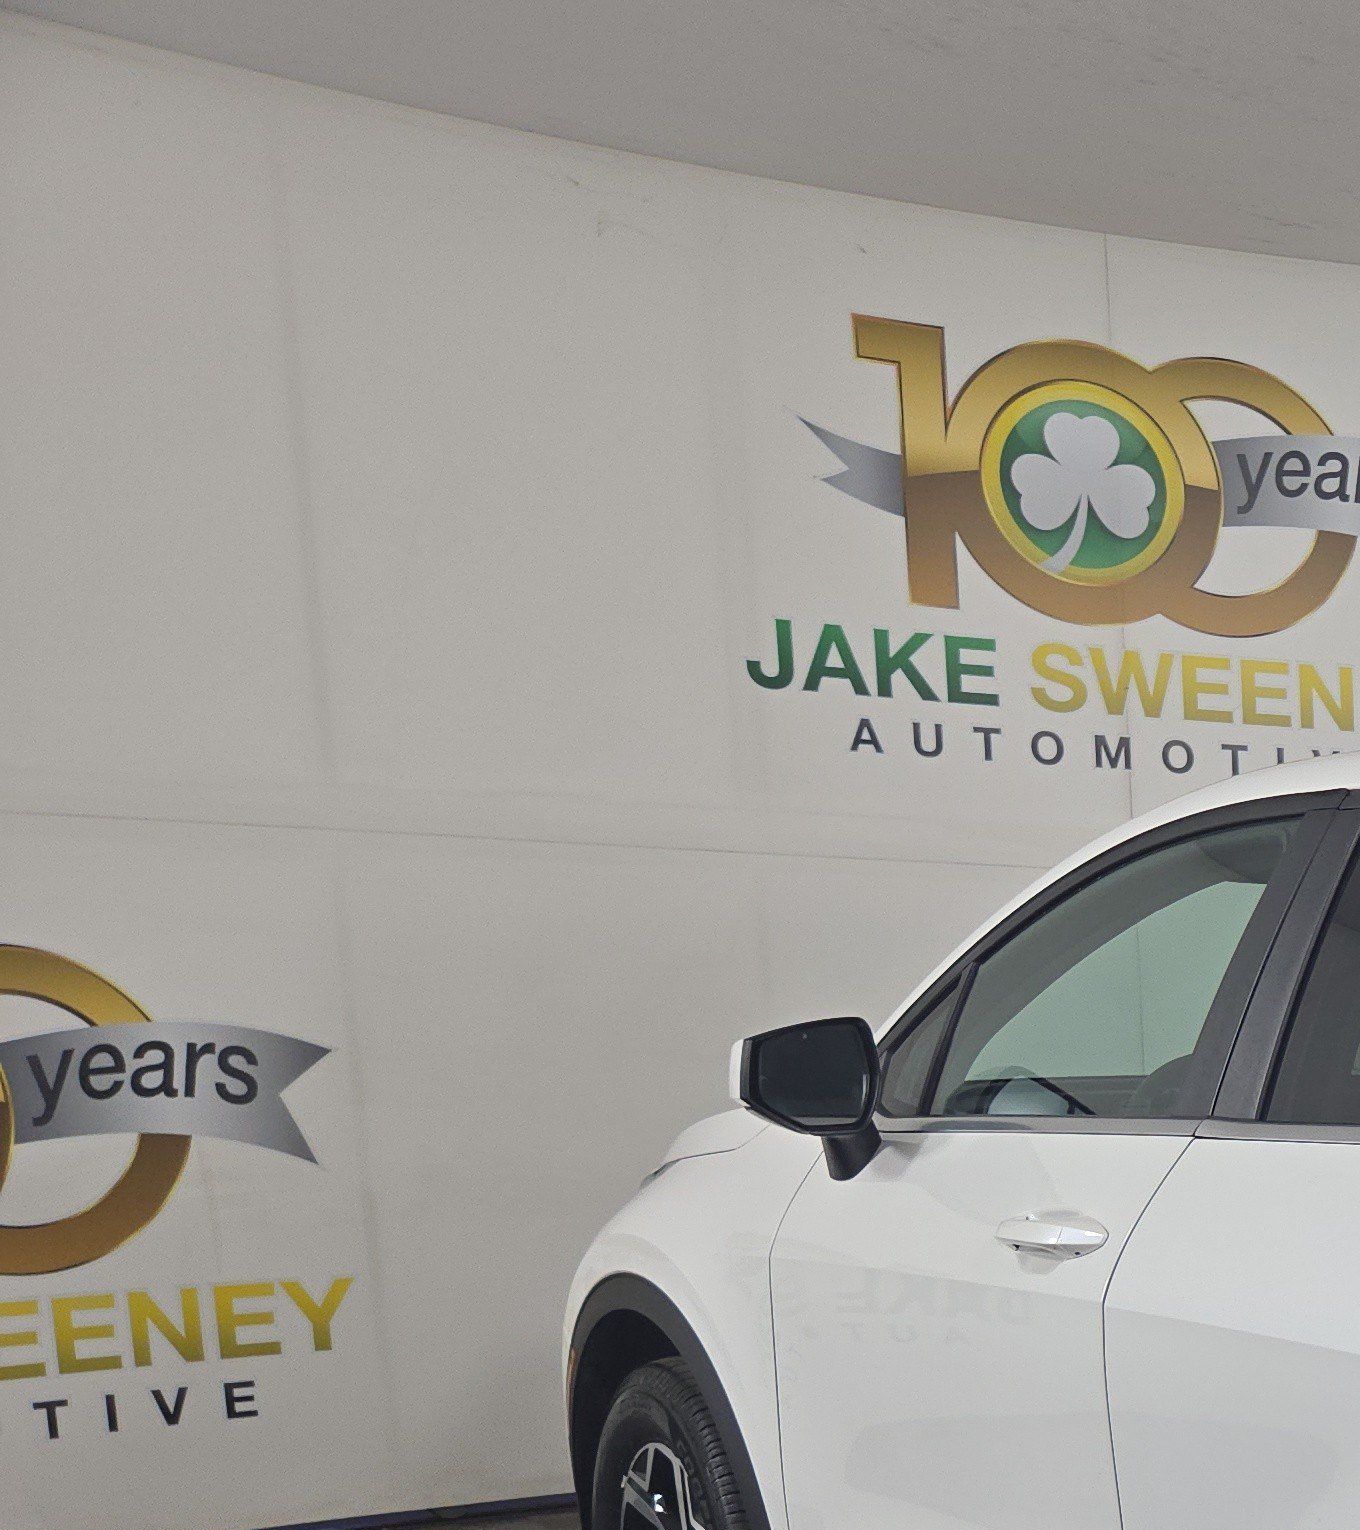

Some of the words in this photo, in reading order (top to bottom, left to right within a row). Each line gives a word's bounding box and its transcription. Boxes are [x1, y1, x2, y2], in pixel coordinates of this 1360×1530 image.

[745, 618, 1000, 707] JAKE
[25, 1040, 259, 1127] years
[0, 1276, 353, 1380] EENEY
